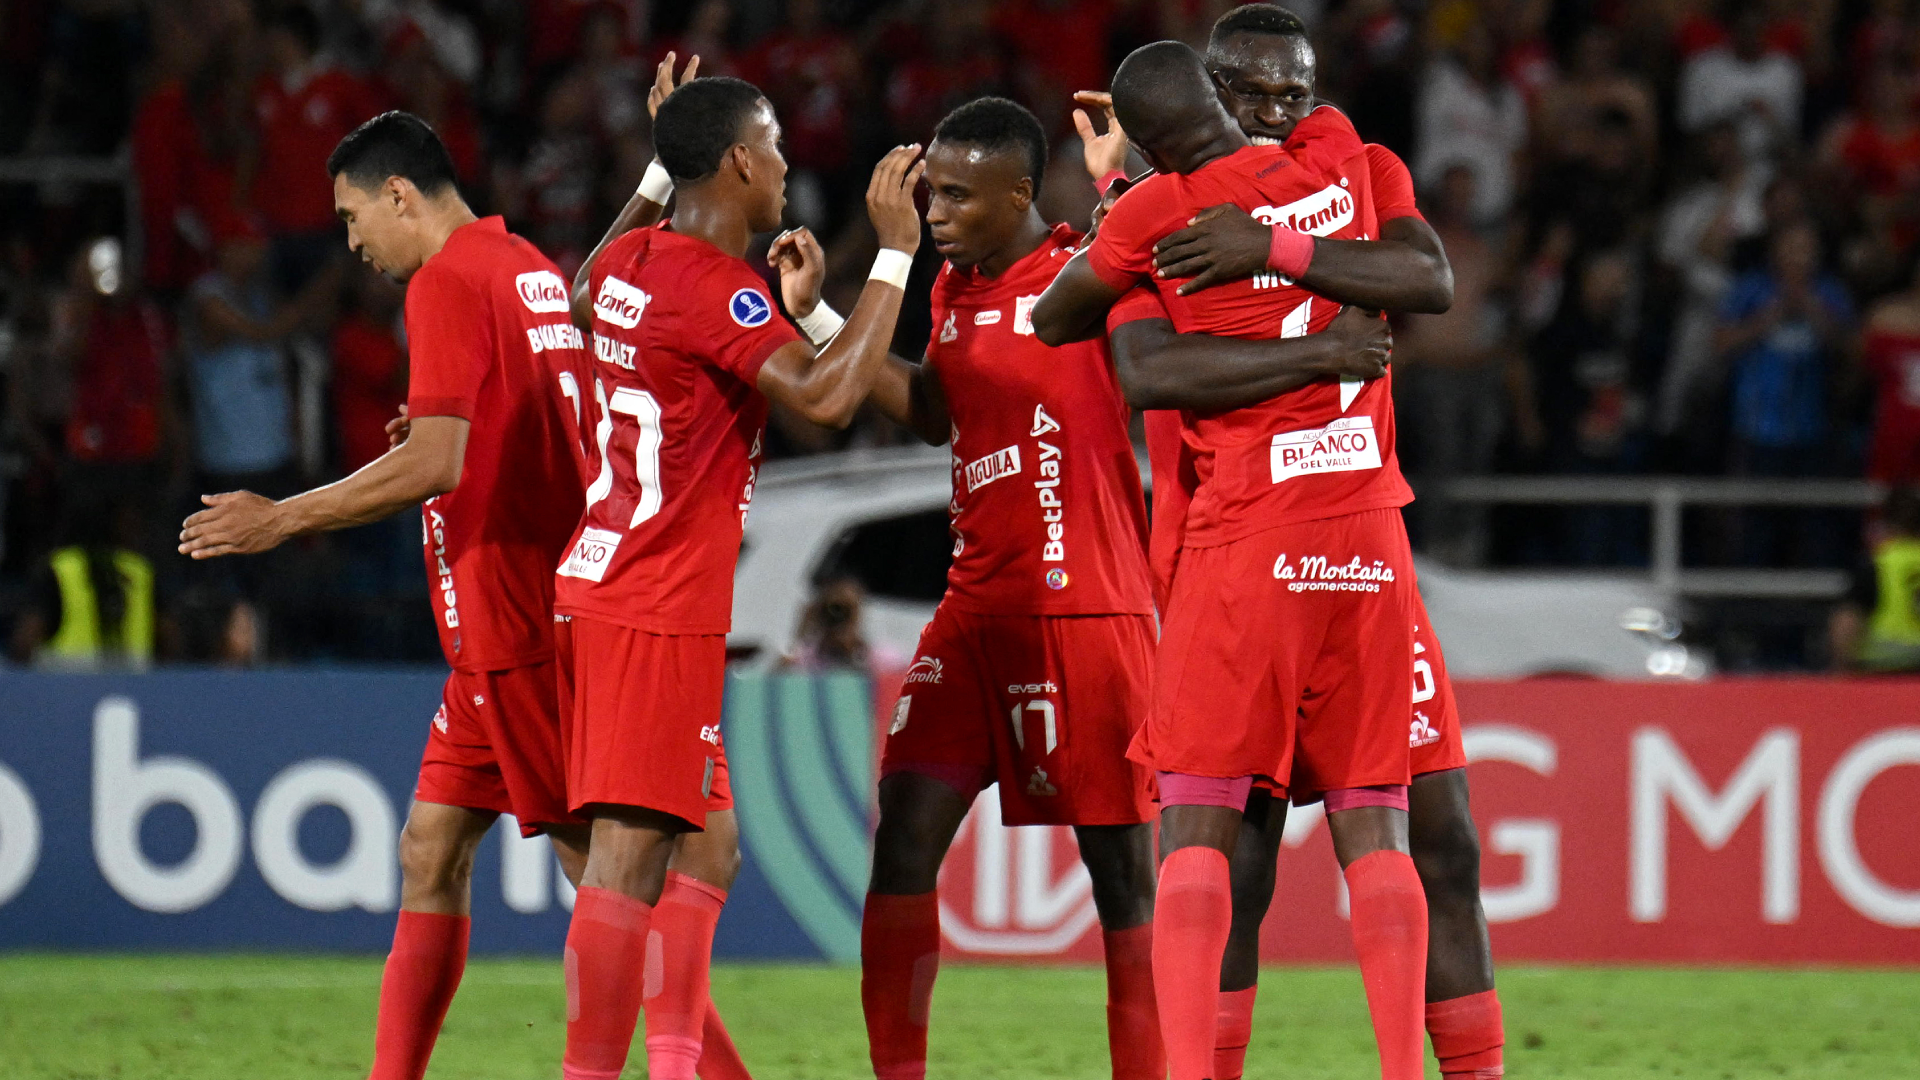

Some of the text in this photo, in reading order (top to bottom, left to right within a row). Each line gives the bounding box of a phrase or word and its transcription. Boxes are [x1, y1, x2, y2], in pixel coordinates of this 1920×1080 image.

[1256, 195, 1351, 232] lanta
[1282, 433, 1368, 468] BLANCO
[1300, 457, 1353, 470] DEL VALLE
[968, 450, 1017, 488] AGUILA
[1034, 441, 1064, 561] BetPlay
[429, 509, 460, 629] BetPlay
[570, 541, 607, 564] ANCO
[1273, 553, 1395, 583] la Montaña
[1287, 581, 1380, 594] agromercados
